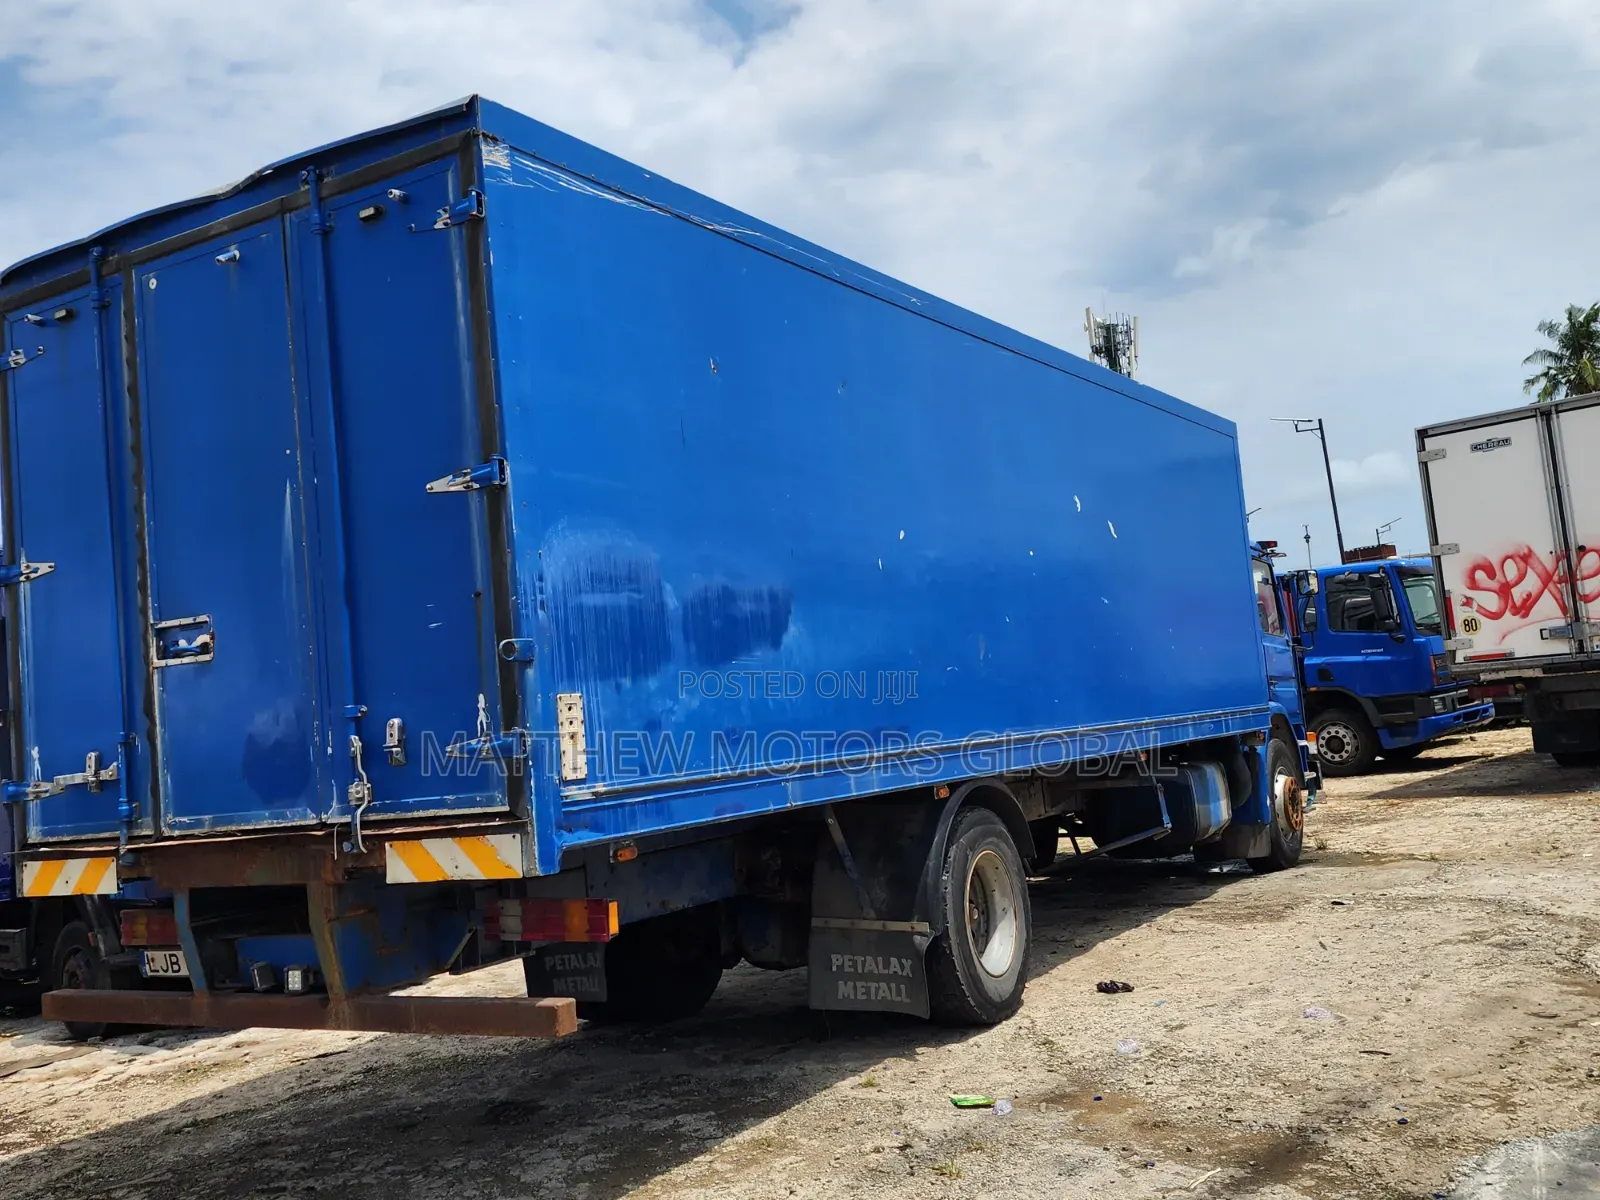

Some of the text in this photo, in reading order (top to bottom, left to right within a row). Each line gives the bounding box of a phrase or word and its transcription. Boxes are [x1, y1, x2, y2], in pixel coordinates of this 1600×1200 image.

[1472, 438, 1510, 451] CHEREAU
[1463, 618, 1478, 632] 80
[146, 953, 181, 974] LJB
[830, 953, 913, 978] PETALAX
[837, 980, 911, 1003] METALL
